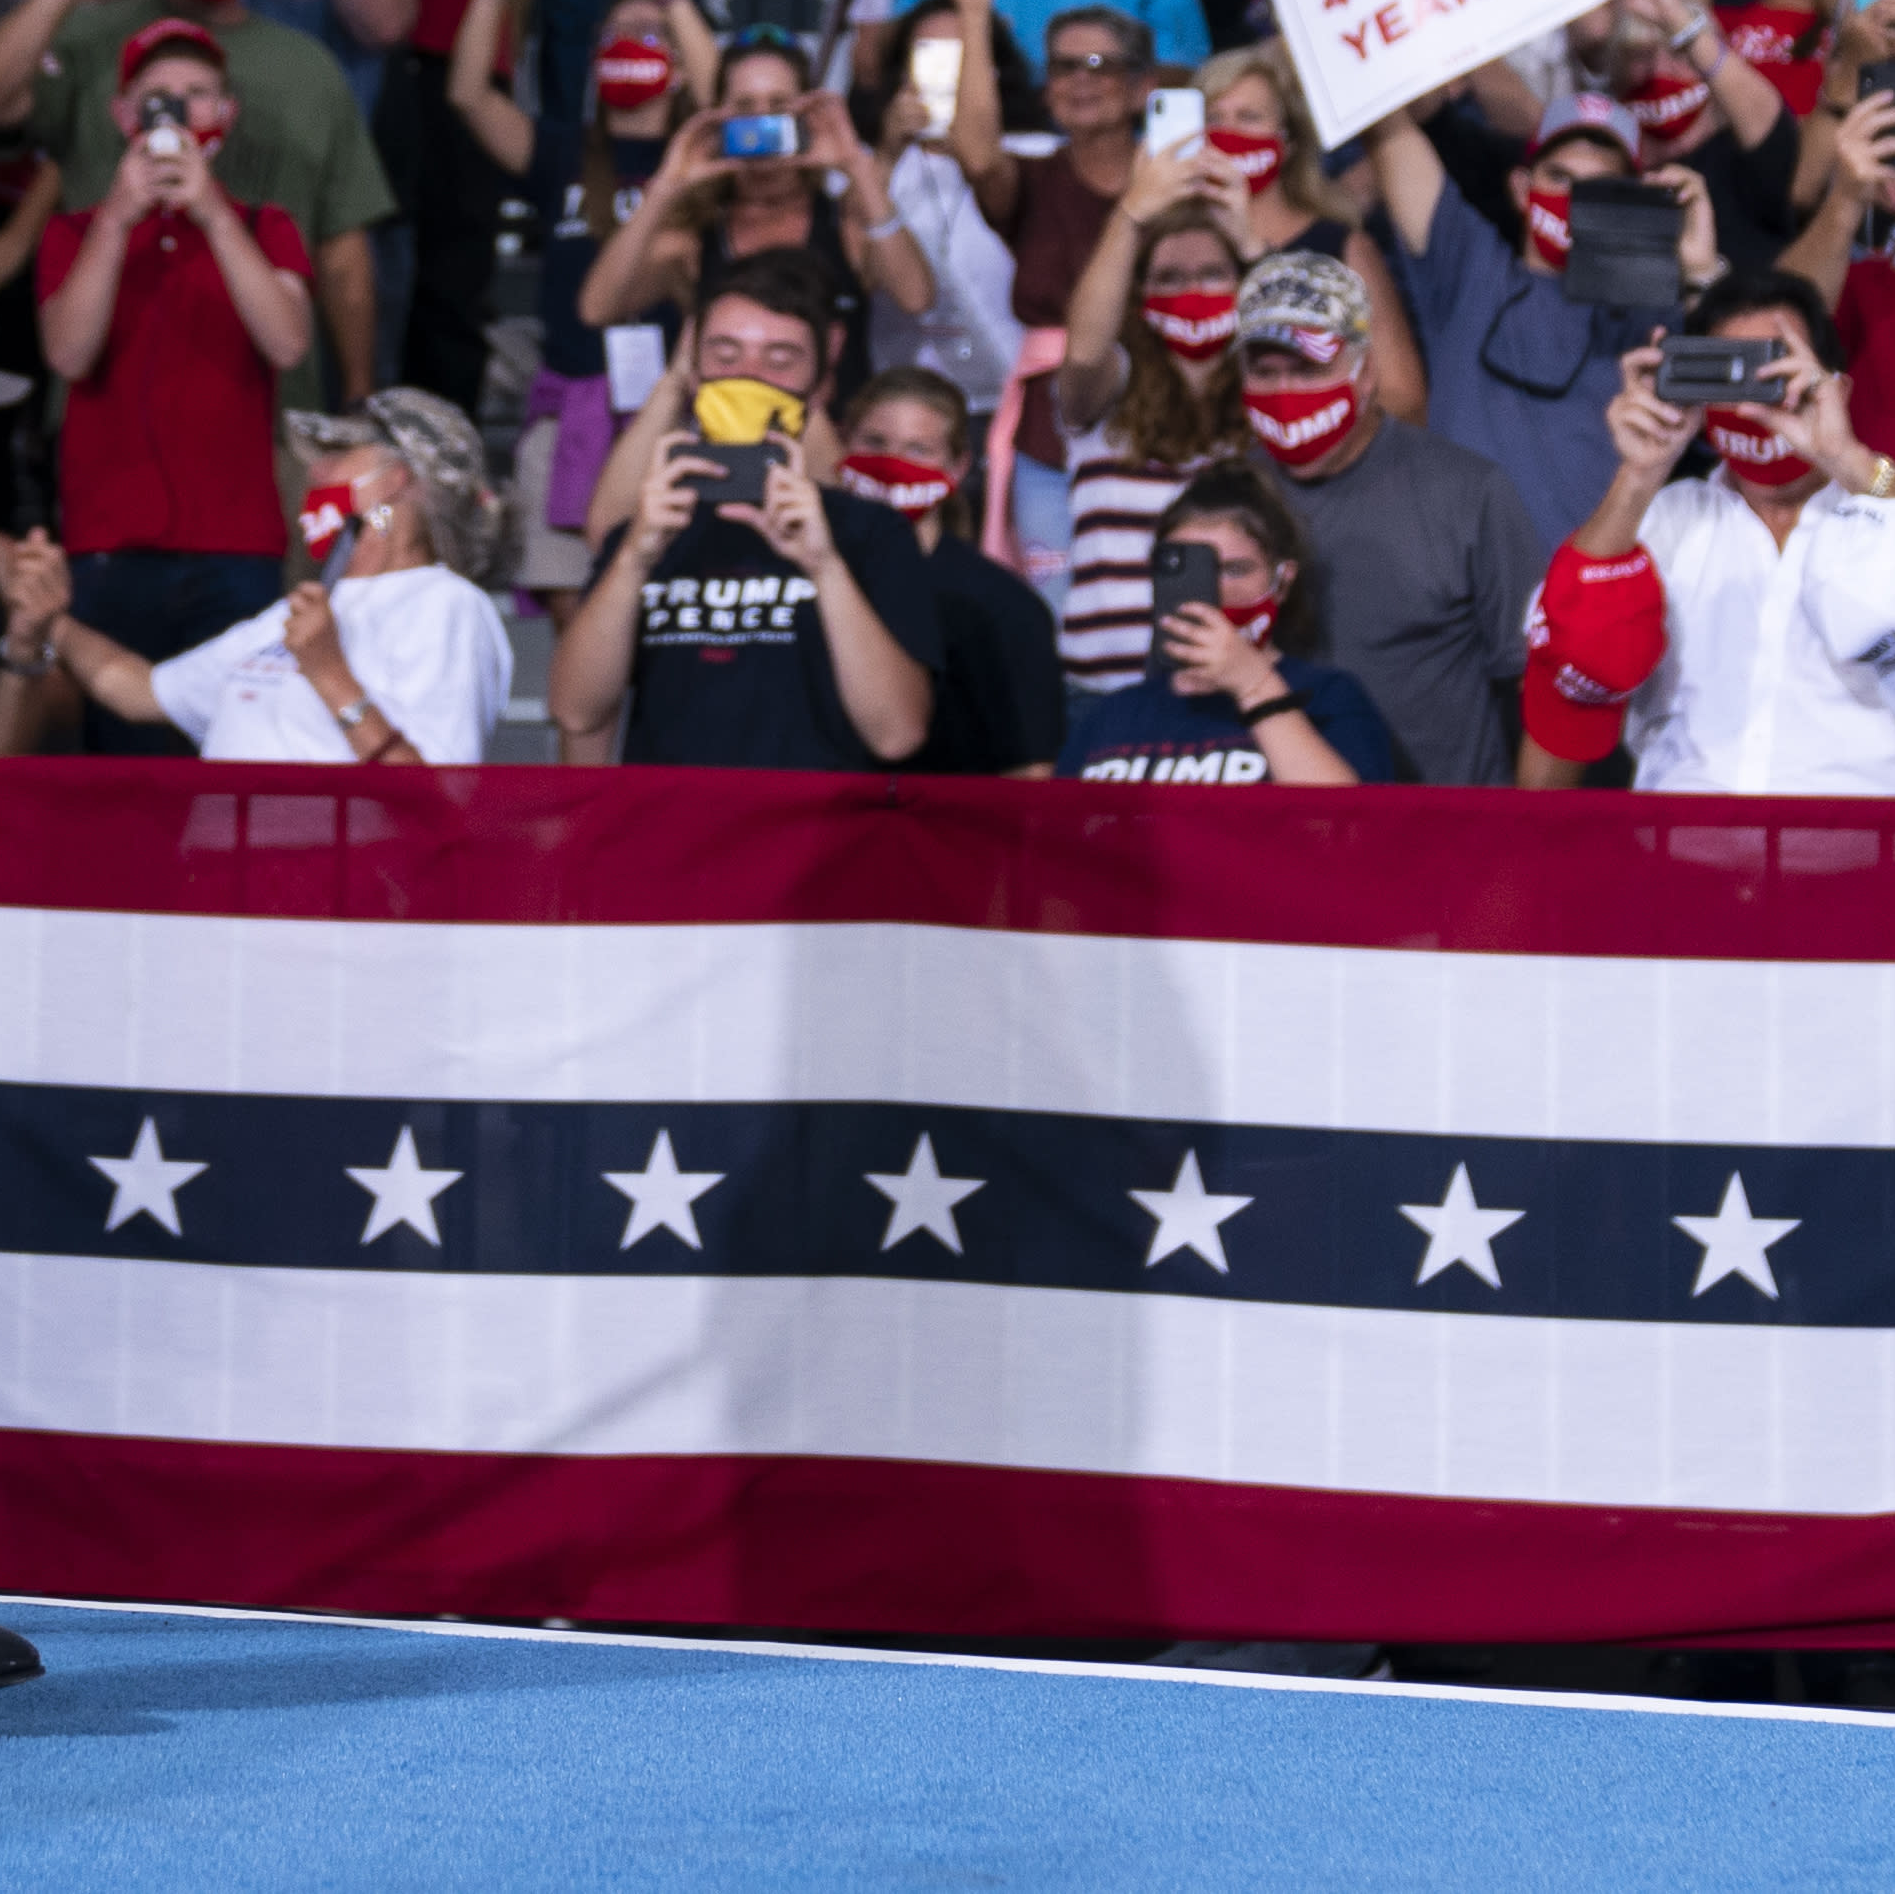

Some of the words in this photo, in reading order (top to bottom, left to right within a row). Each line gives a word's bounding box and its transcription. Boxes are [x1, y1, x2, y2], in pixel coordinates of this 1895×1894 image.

[1247, 397, 1353, 451] TRUMP
[640, 575, 818, 609] TRUMP
[646, 607, 797, 632] PENCE
